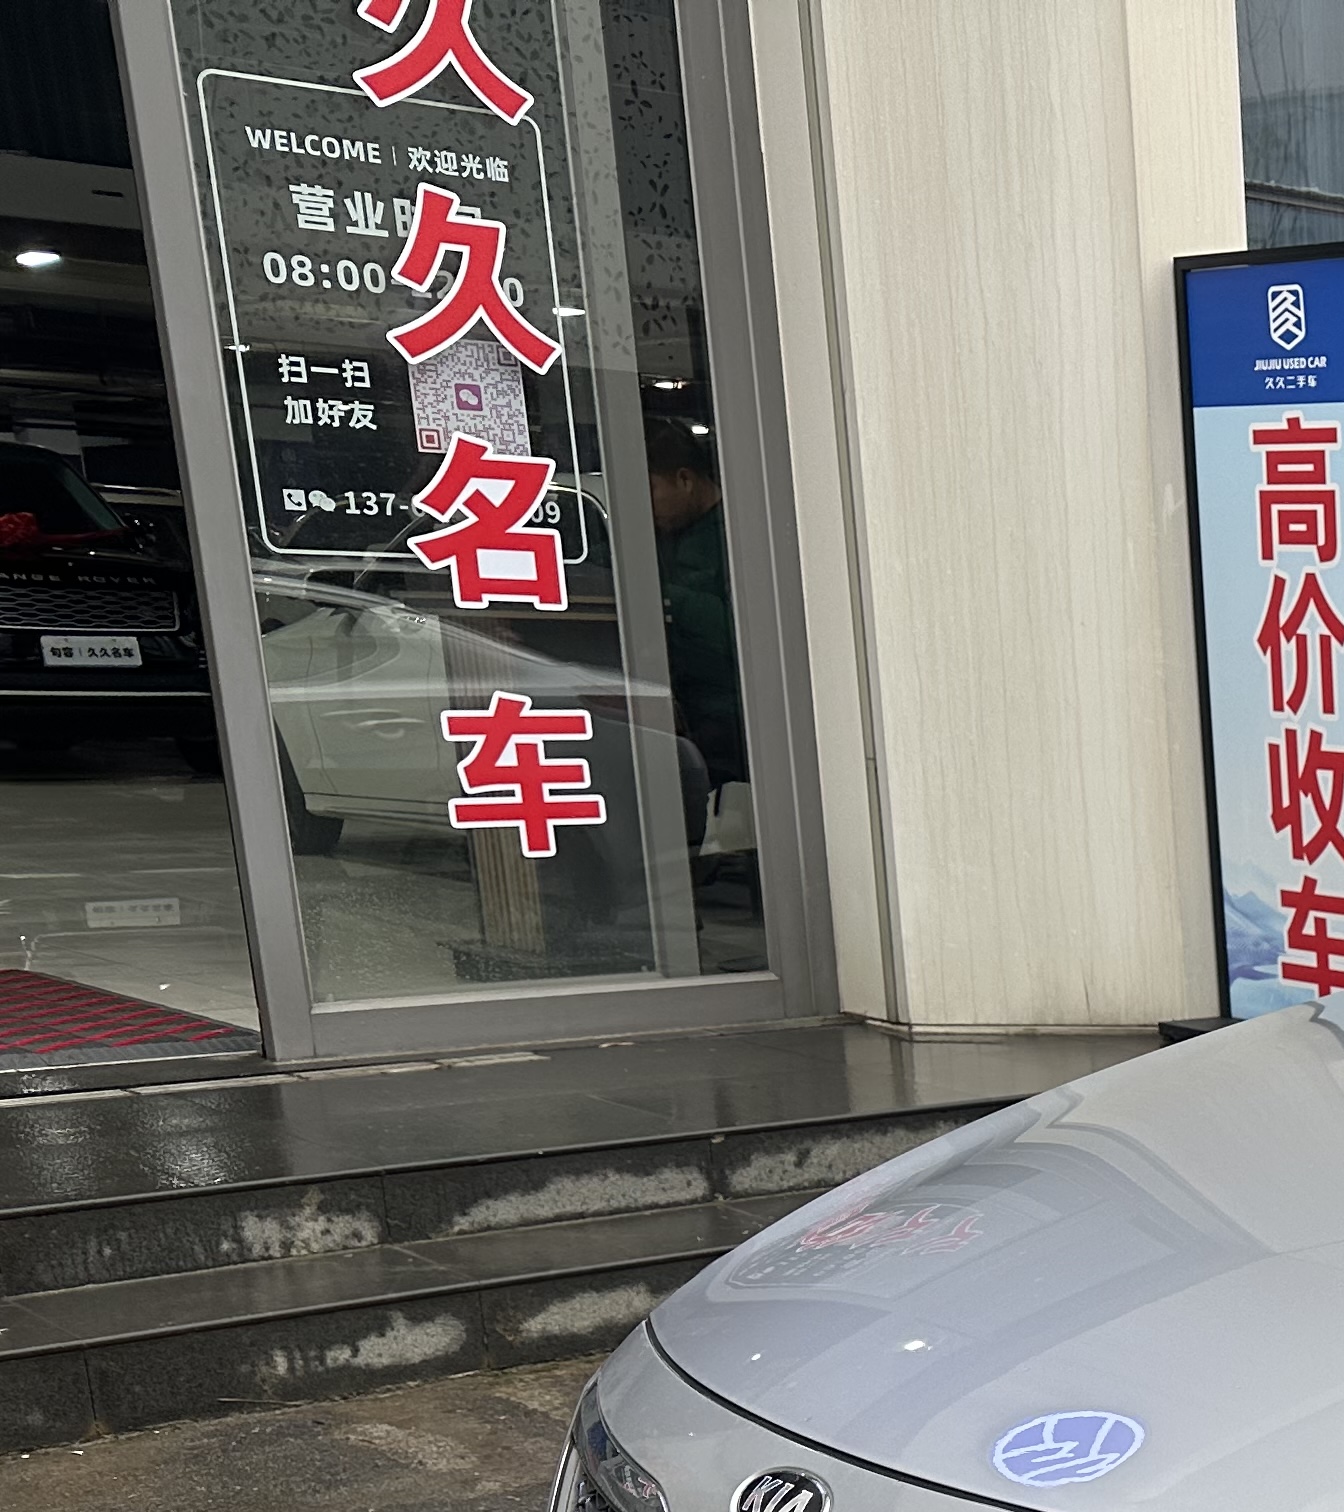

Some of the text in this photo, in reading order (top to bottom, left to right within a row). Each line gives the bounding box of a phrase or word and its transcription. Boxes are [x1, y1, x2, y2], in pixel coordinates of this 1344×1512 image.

[244, 125, 382, 165] WELCOME
[407, 146, 510, 183] 欢迎光临
[288, 183, 482, 239] 营业
[278, 354, 371, 388] 扫一扫
[1254, 356, 1327, 371] JIUJIU USED CAR
[1265, 375, 1317, 389] 久久二手车
[284, 396, 377, 430] 加好友
[353, 0, 606, 858] 久久名车
[88, 647, 134, 658] 久久名车
